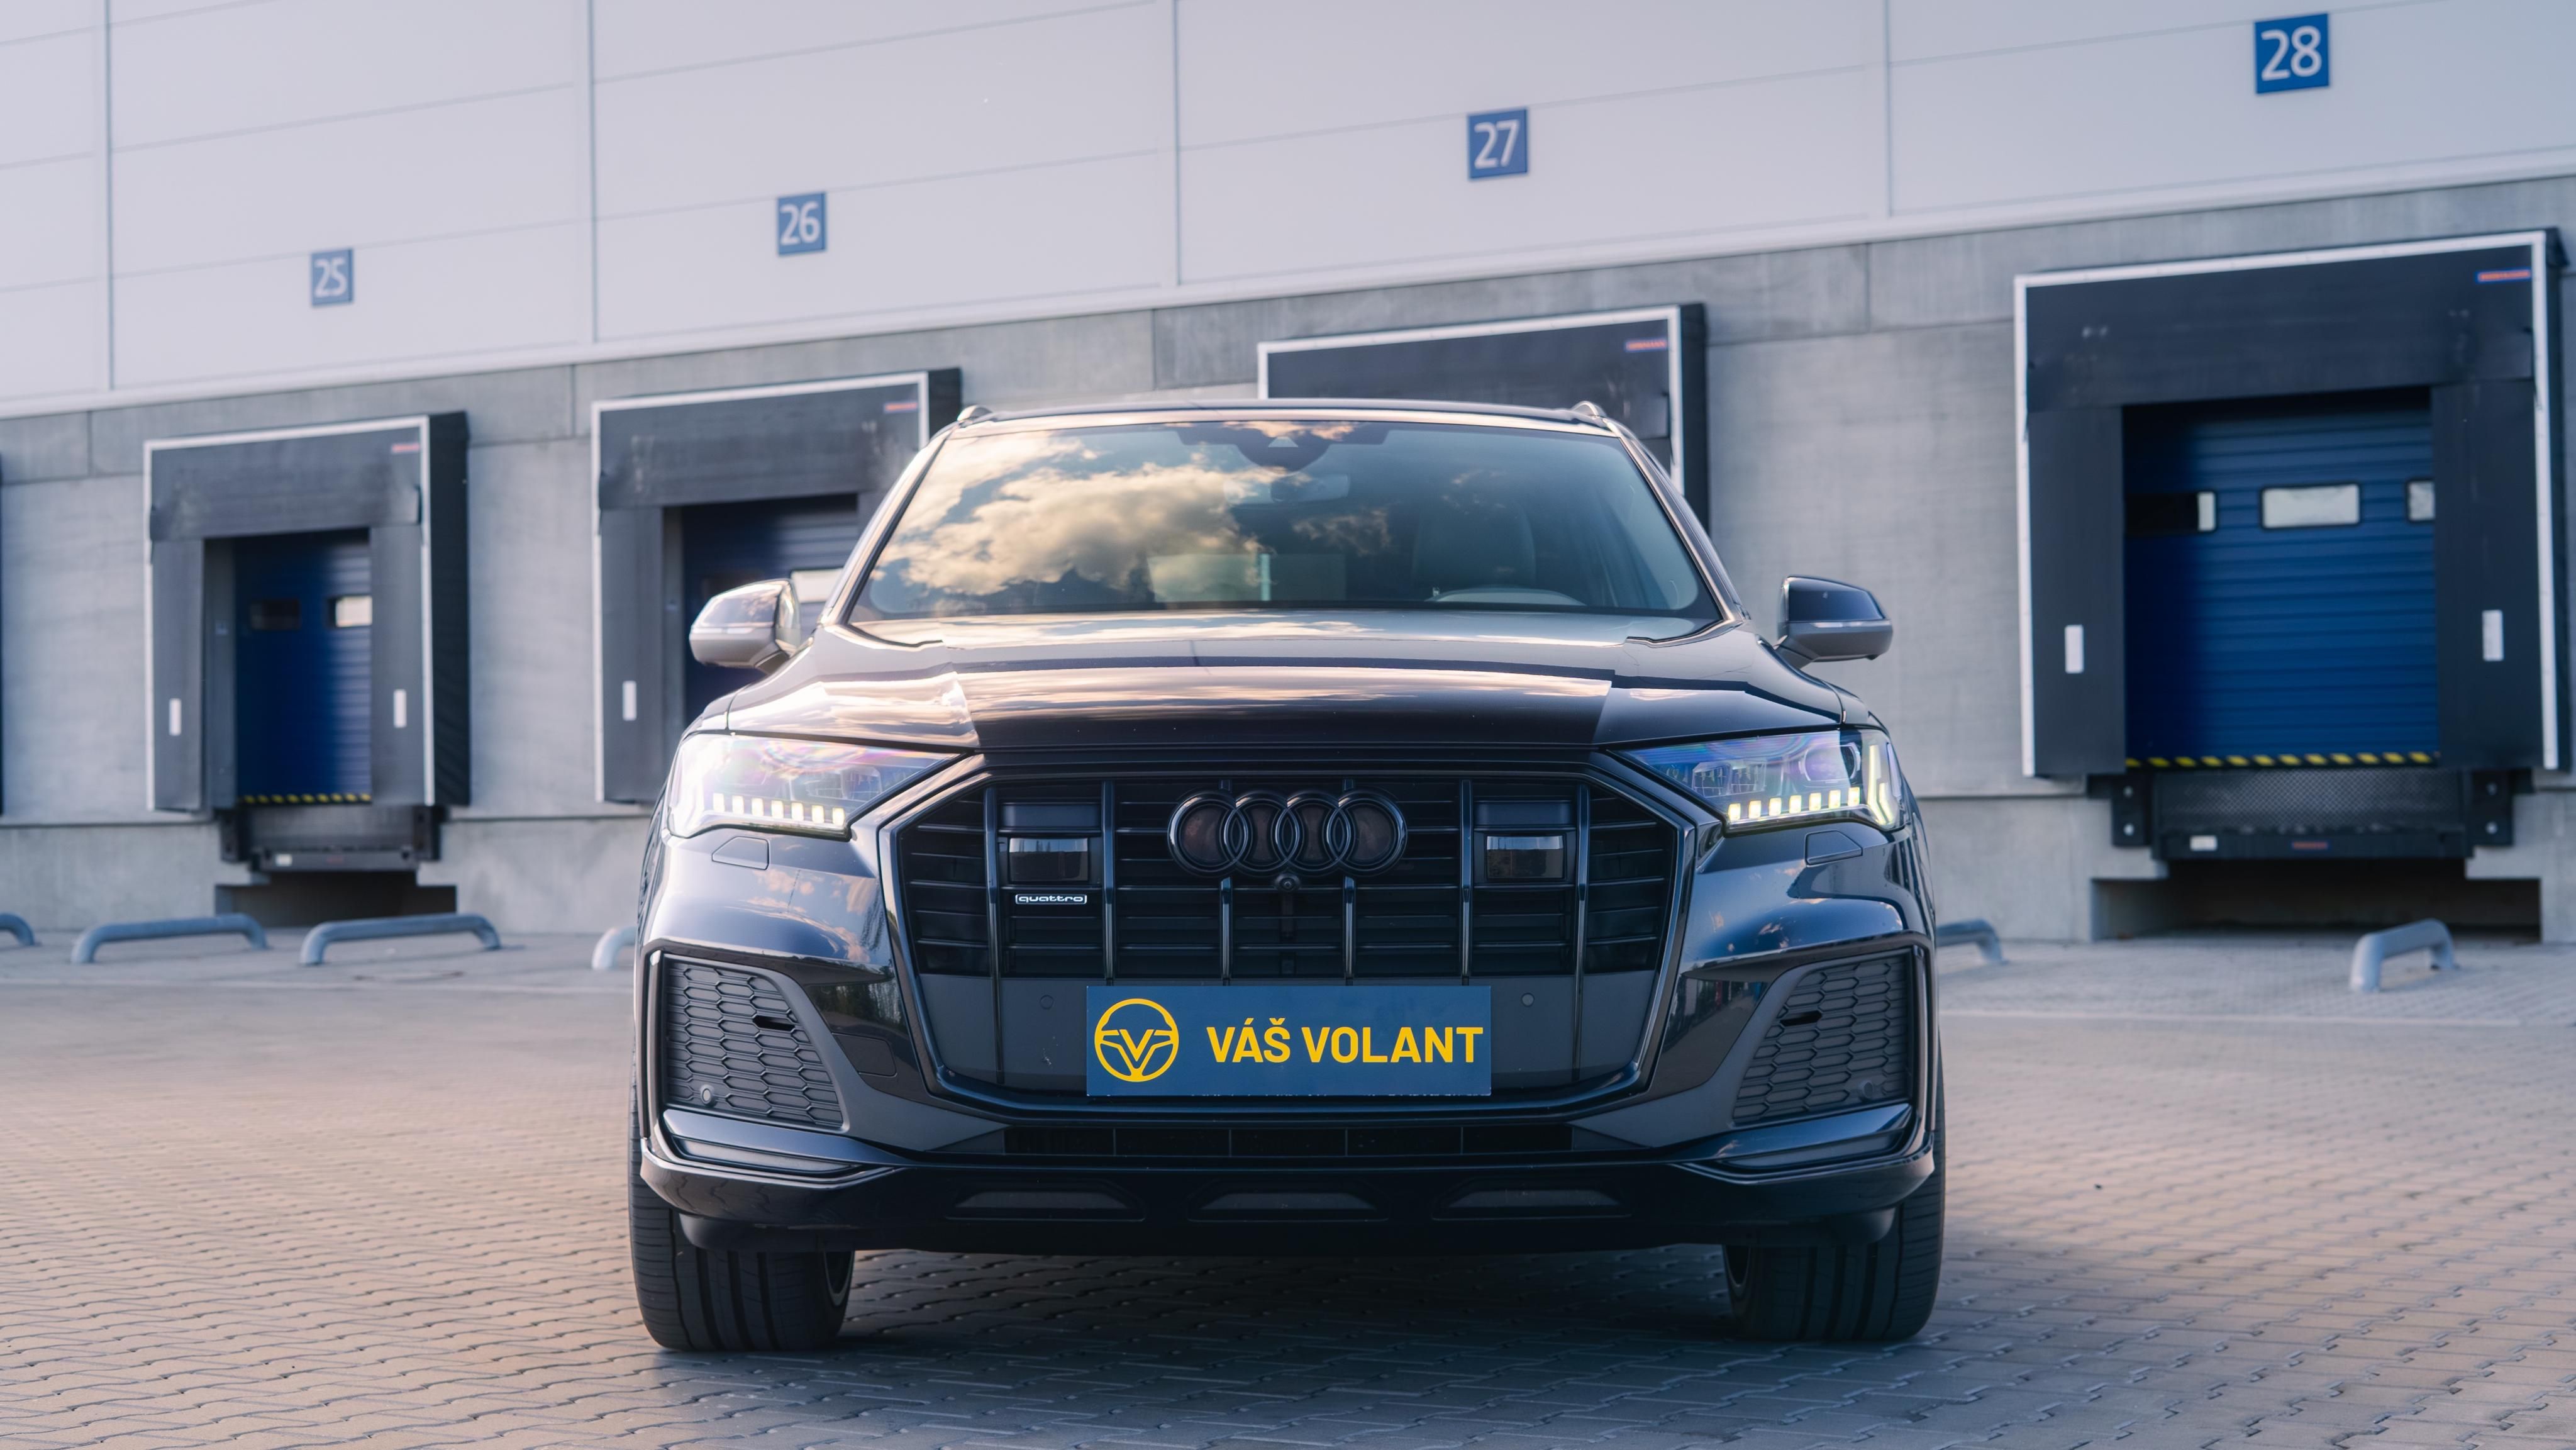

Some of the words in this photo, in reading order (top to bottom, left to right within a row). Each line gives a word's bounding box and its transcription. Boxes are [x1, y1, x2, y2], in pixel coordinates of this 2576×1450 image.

[2260, 25, 2323, 81] 28
[1474, 119, 1519, 169] 27
[780, 201, 821, 245] 26
[315, 257, 347, 298] 25
[1018, 895, 1084, 903] quattro
[1207, 1017, 1291, 1063] VÁŠ
[1301, 1026, 1484, 1063] VOLANT
